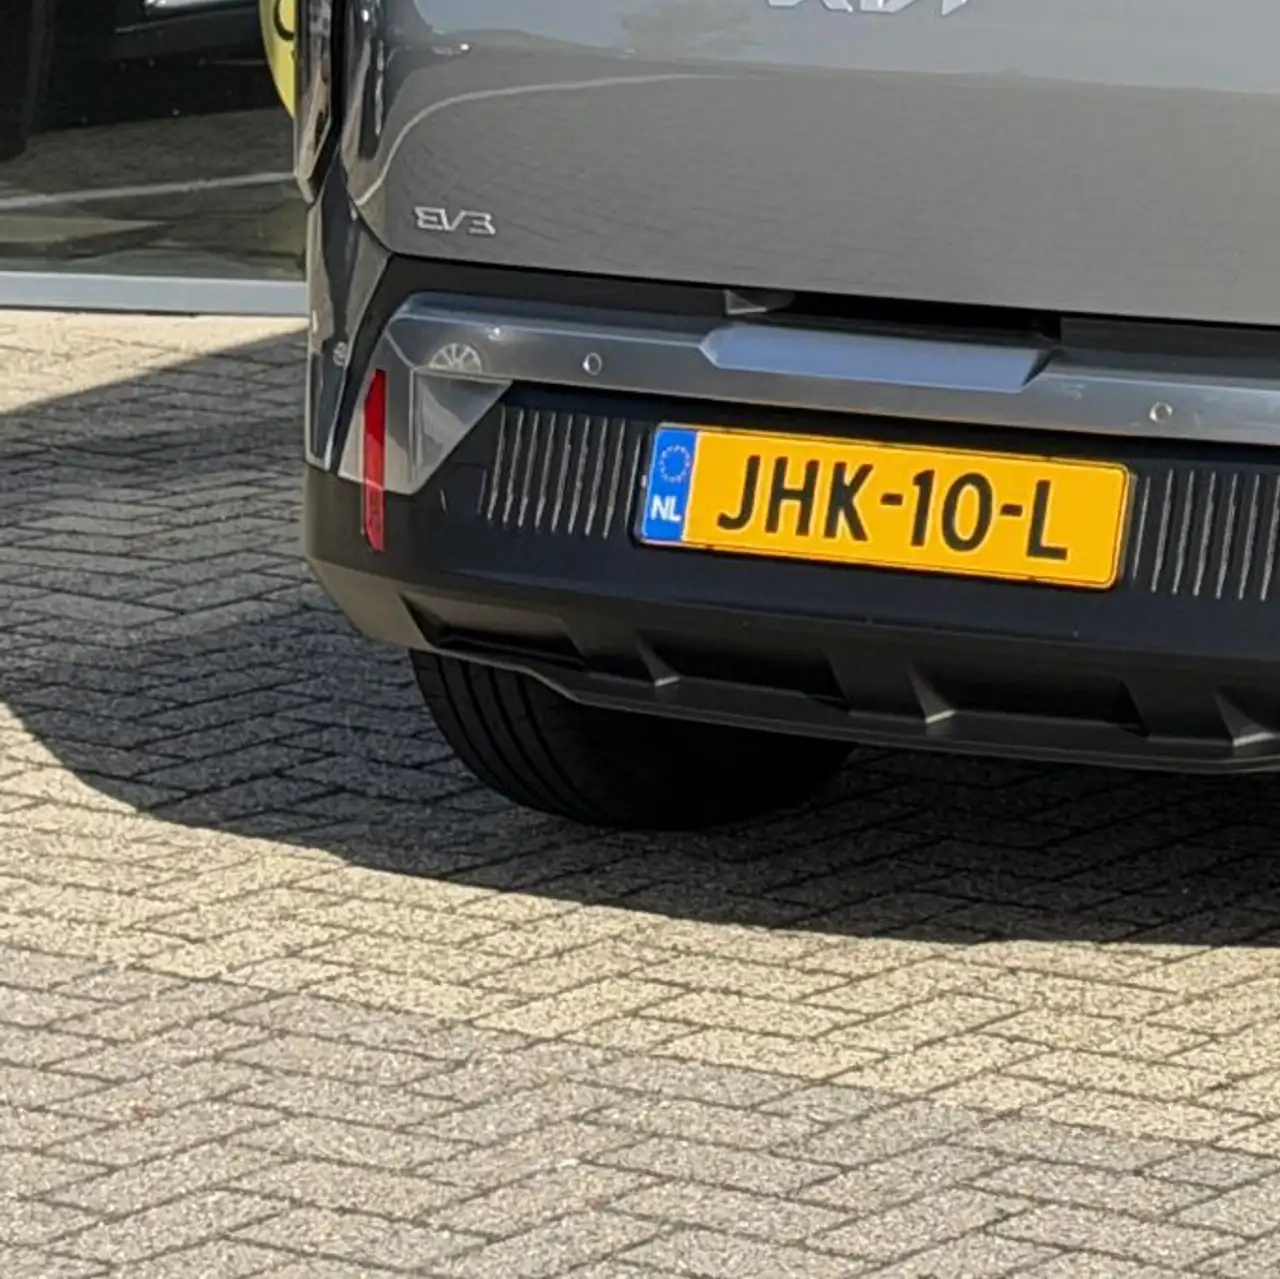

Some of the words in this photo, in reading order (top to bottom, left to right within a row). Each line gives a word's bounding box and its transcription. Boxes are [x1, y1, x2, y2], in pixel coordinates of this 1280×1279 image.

[415, 206, 496, 236] EV3
[650, 494, 682, 522] NL
[716, 454, 1068, 563] JHK-10-L
